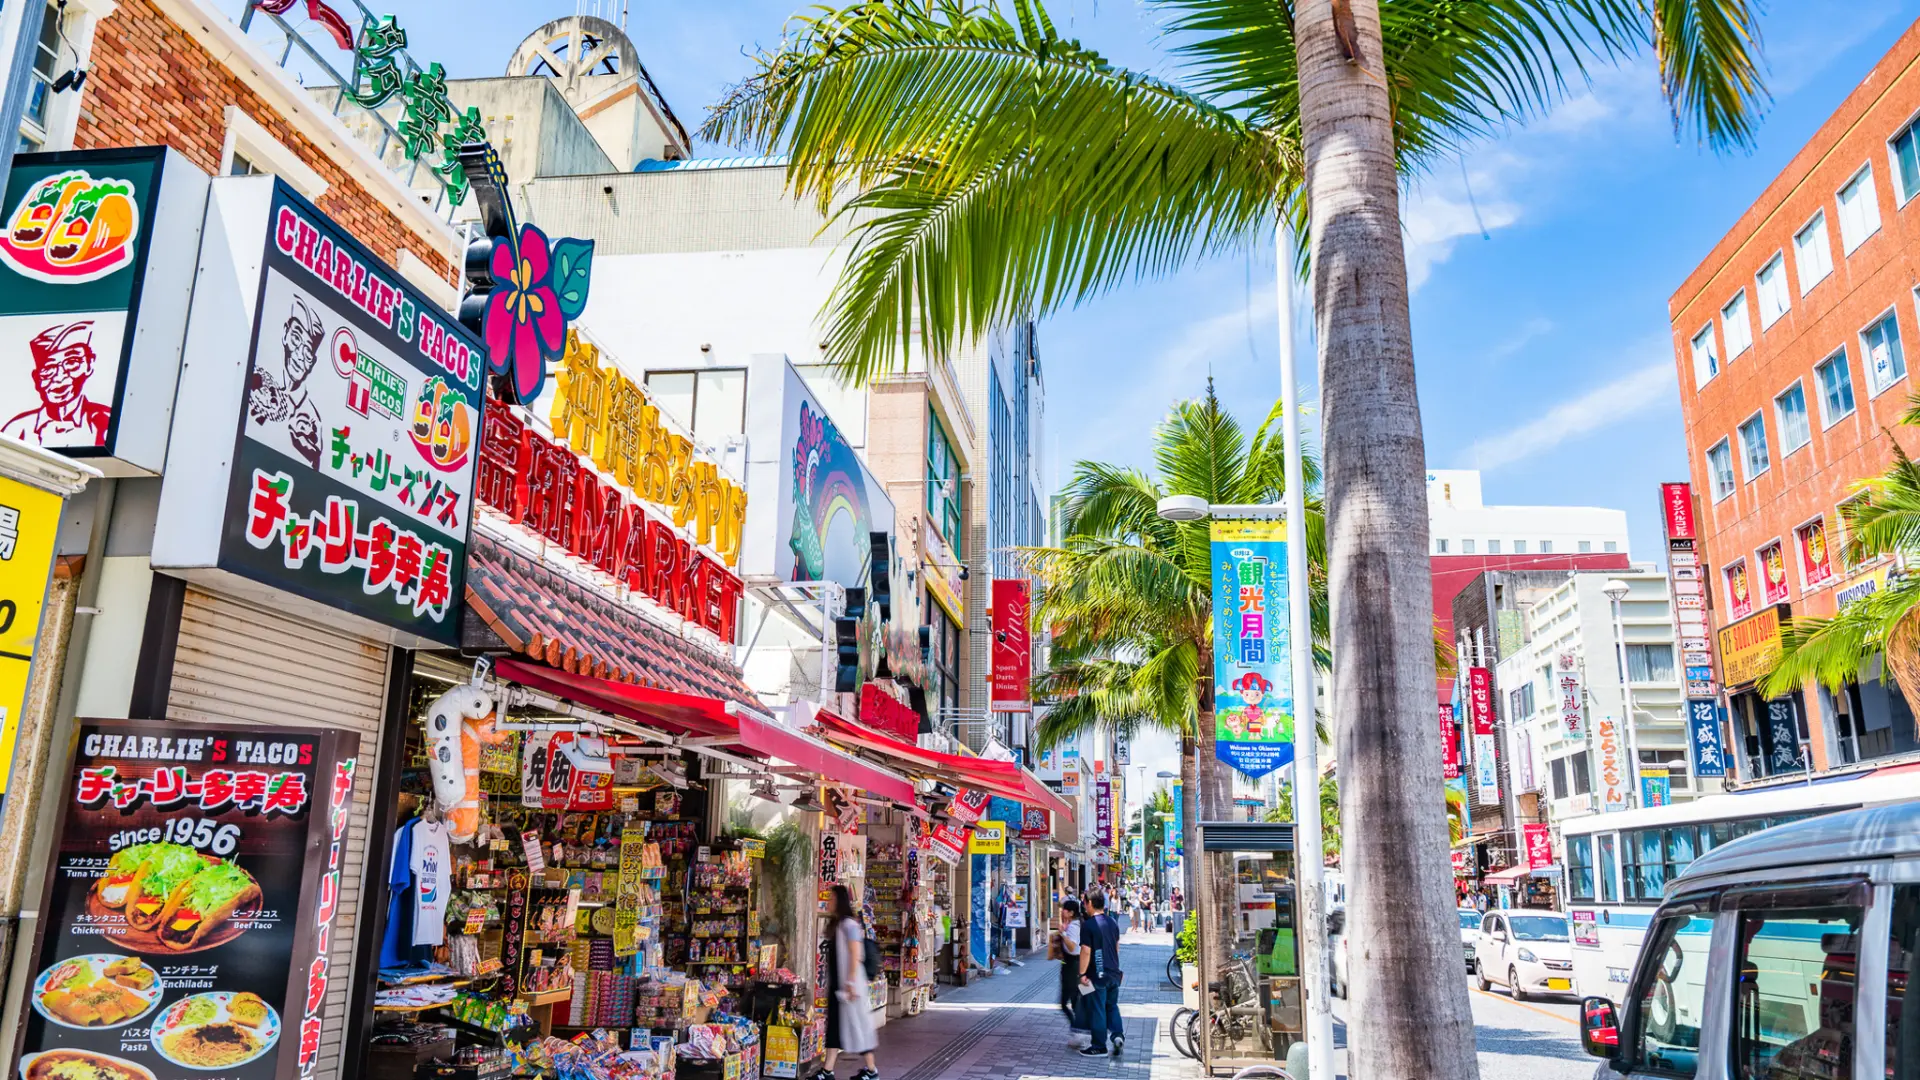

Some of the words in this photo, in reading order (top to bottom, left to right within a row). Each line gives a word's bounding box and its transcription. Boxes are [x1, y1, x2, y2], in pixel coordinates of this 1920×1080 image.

[275, 205, 415, 343] CHARLIE'S
[418, 311, 481, 392] TACOS
[246, 467, 452, 624] チャーリー多幸寿
[1733, 624, 1750, 652] SOUL
[1749, 618, 1759, 645] TO
[996, 664, 1017, 672] Sports
[996, 673, 1014, 681] Darts
[996, 683, 1018, 691] Dining
[1560, 676, 1581, 731] 守礼堂
[1693, 701, 1721, 768] 泡盛蔵
[84, 733, 228, 763] CHARLIE'S
[236, 740, 313, 765] TACOS
[1599, 718, 1623, 803] どらえもん
[78, 766, 309, 814] チャーリー多幸寿
[109, 826, 161, 852] Since
[163, 817, 241, 856] 1956
[69, 857, 110, 867] ツナタコス
[821, 835, 837, 883] 免税
[66, 869, 87, 878] Tuna
[89, 869, 110, 878] Taco
[75, 914, 127, 923] チキンタコス
[231, 909, 278, 918] ビーフタコス
[298, 757, 357, 1080] チャーリー多幸
[71, 926, 105, 936] Chicken
[107, 927, 127, 936] Taco
[233, 921, 251, 930] Beef
[251, 921, 273, 930] Taco
[162, 964, 218, 976] エンチラーダ
[162, 979, 214, 989] Enchiladas
[121, 1028, 150, 1039] パスタ
[120, 1042, 148, 1052] Pasta
